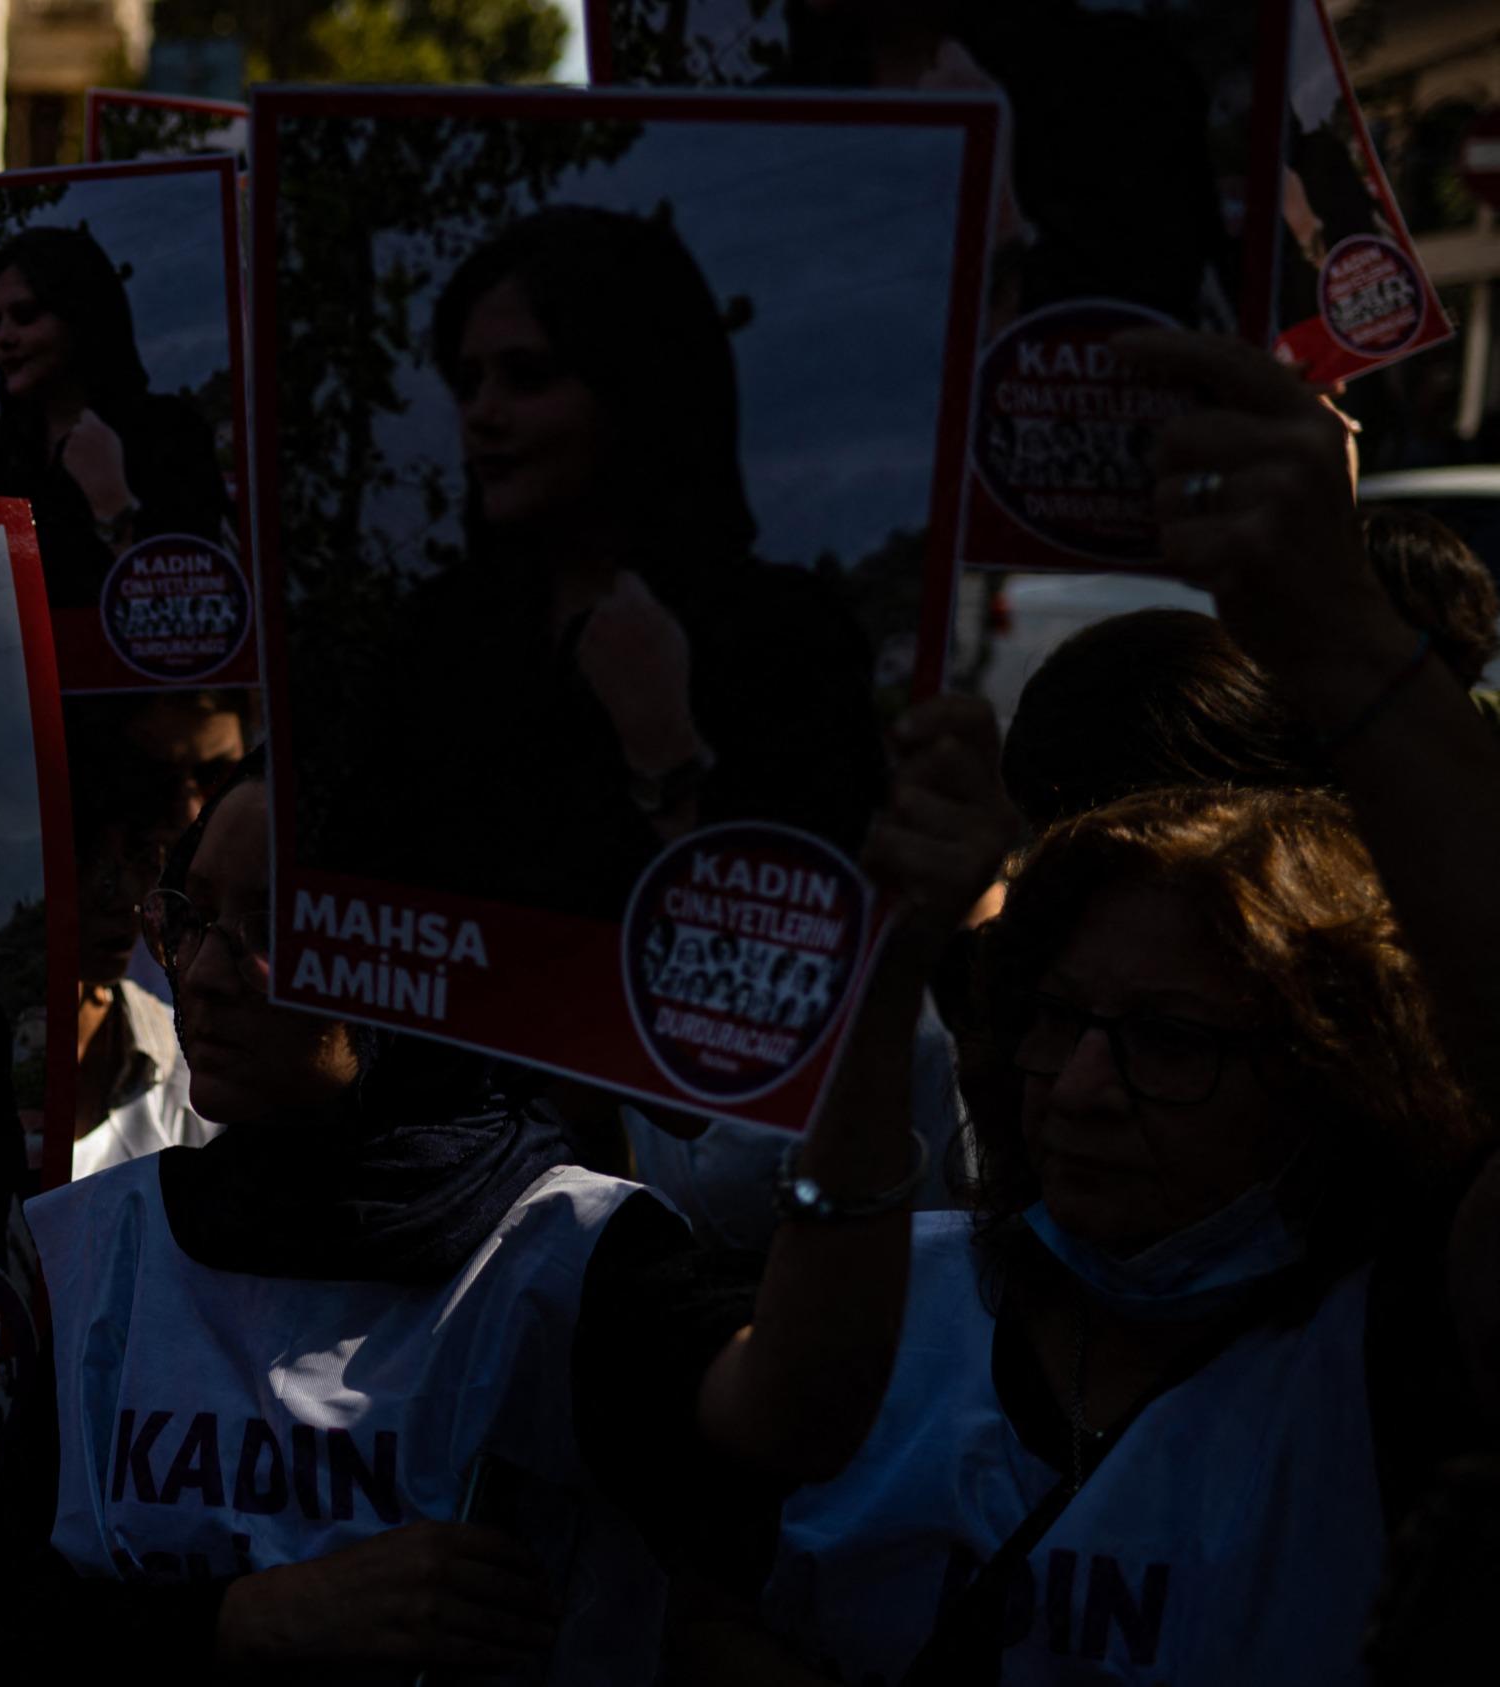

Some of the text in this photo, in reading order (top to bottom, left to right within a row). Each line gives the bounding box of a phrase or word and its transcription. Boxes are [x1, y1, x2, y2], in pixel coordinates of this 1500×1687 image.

[1016, 338, 1133, 384] KAD
[132, 552, 213, 576] KADIN
[691, 849, 839, 912] KADIN
[292, 888, 490, 970] MAHSA
[291, 945, 450, 1022] AMİNİ
[111, 1409, 404, 1524] KADIN
